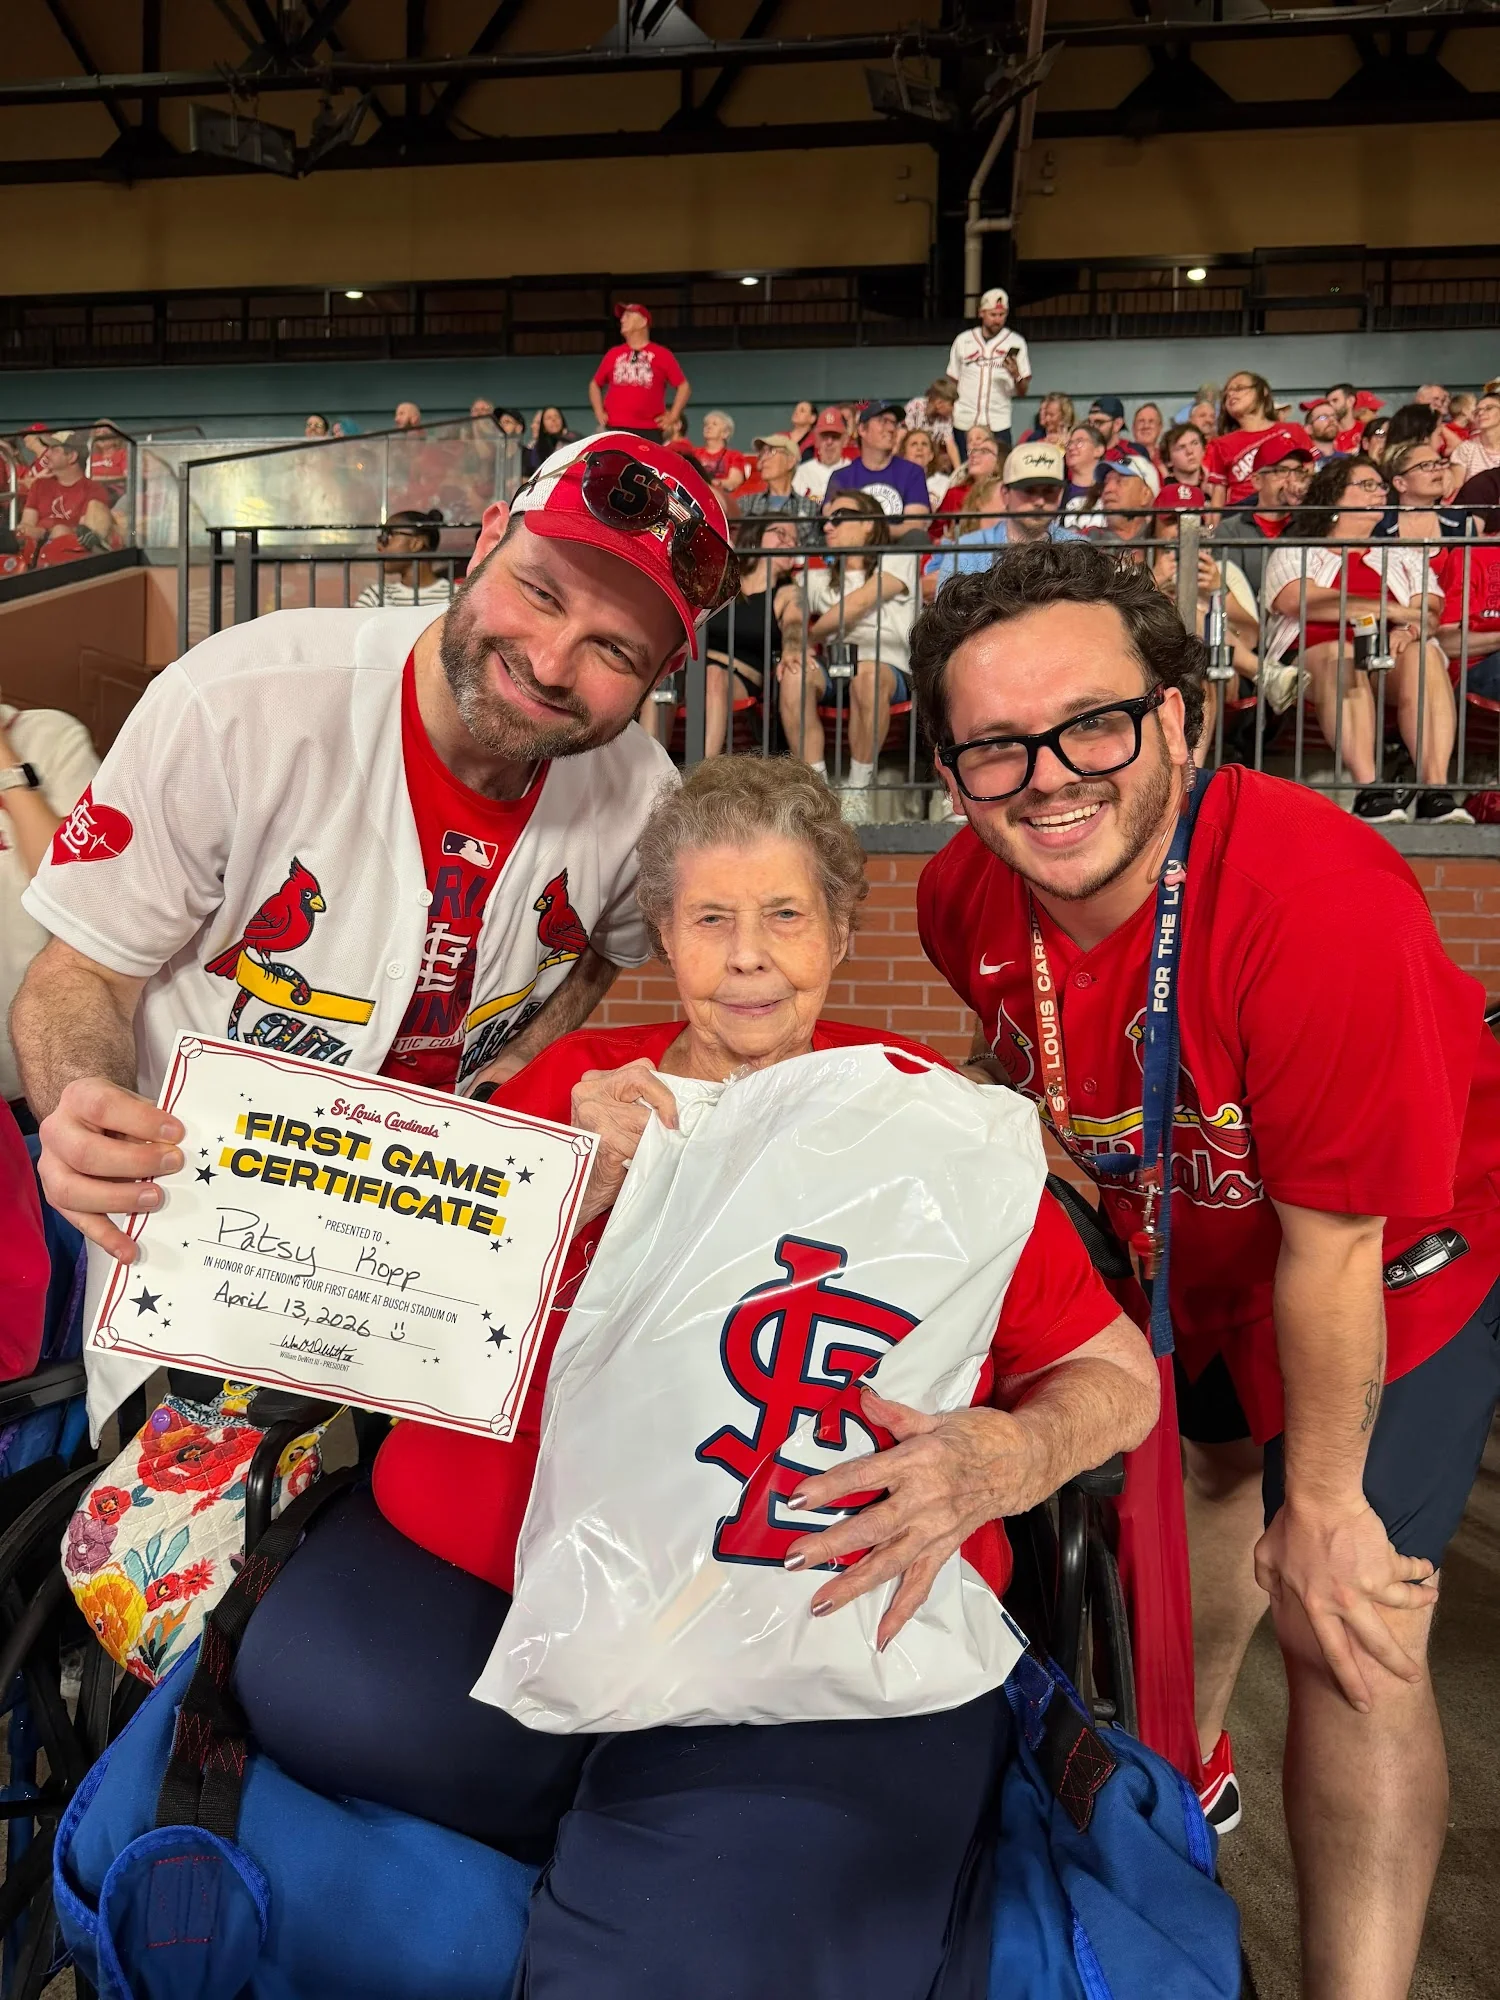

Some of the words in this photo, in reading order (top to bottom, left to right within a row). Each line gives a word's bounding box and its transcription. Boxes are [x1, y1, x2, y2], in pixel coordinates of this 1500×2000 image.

[1158, 913, 1176, 959] THE
[1153, 966, 1171, 1013] FOR
[1040, 1000, 1061, 1069] LOUIS
[384, 1111, 440, 1138] Cardinals
[244, 1111, 372, 1162] FIRST
[381, 1143, 506, 1199] GAME
[230, 1147, 499, 1236] CERTIFICATE
[215, 1207, 316, 1278] Patsy
[355, 1245, 421, 1292] Kopp
[324, 1219, 371, 1240] PRESENTED
[372, 1230, 383, 1242] TO
[203, 1255, 214, 1267] IN
[214, 1257, 244, 1274] HONOR
[244, 1264, 256, 1276] OF
[255, 1268, 301, 1287] ATTENDING
[302, 1277, 324, 1293] YOUR
[324, 1283, 348, 1298] FIRST
[347, 1288, 372, 1304] GAME
[371, 1294, 383, 1305] AT
[383, 1296, 411, 1312] BUSCH
[410, 1303, 446, 1321] STADIUM
[445, 1311, 459, 1324] ON
[213, 1280, 269, 1310] April
[279, 1350, 297, 1361] William
[322, 1360, 351, 1372] PRESIDENT
